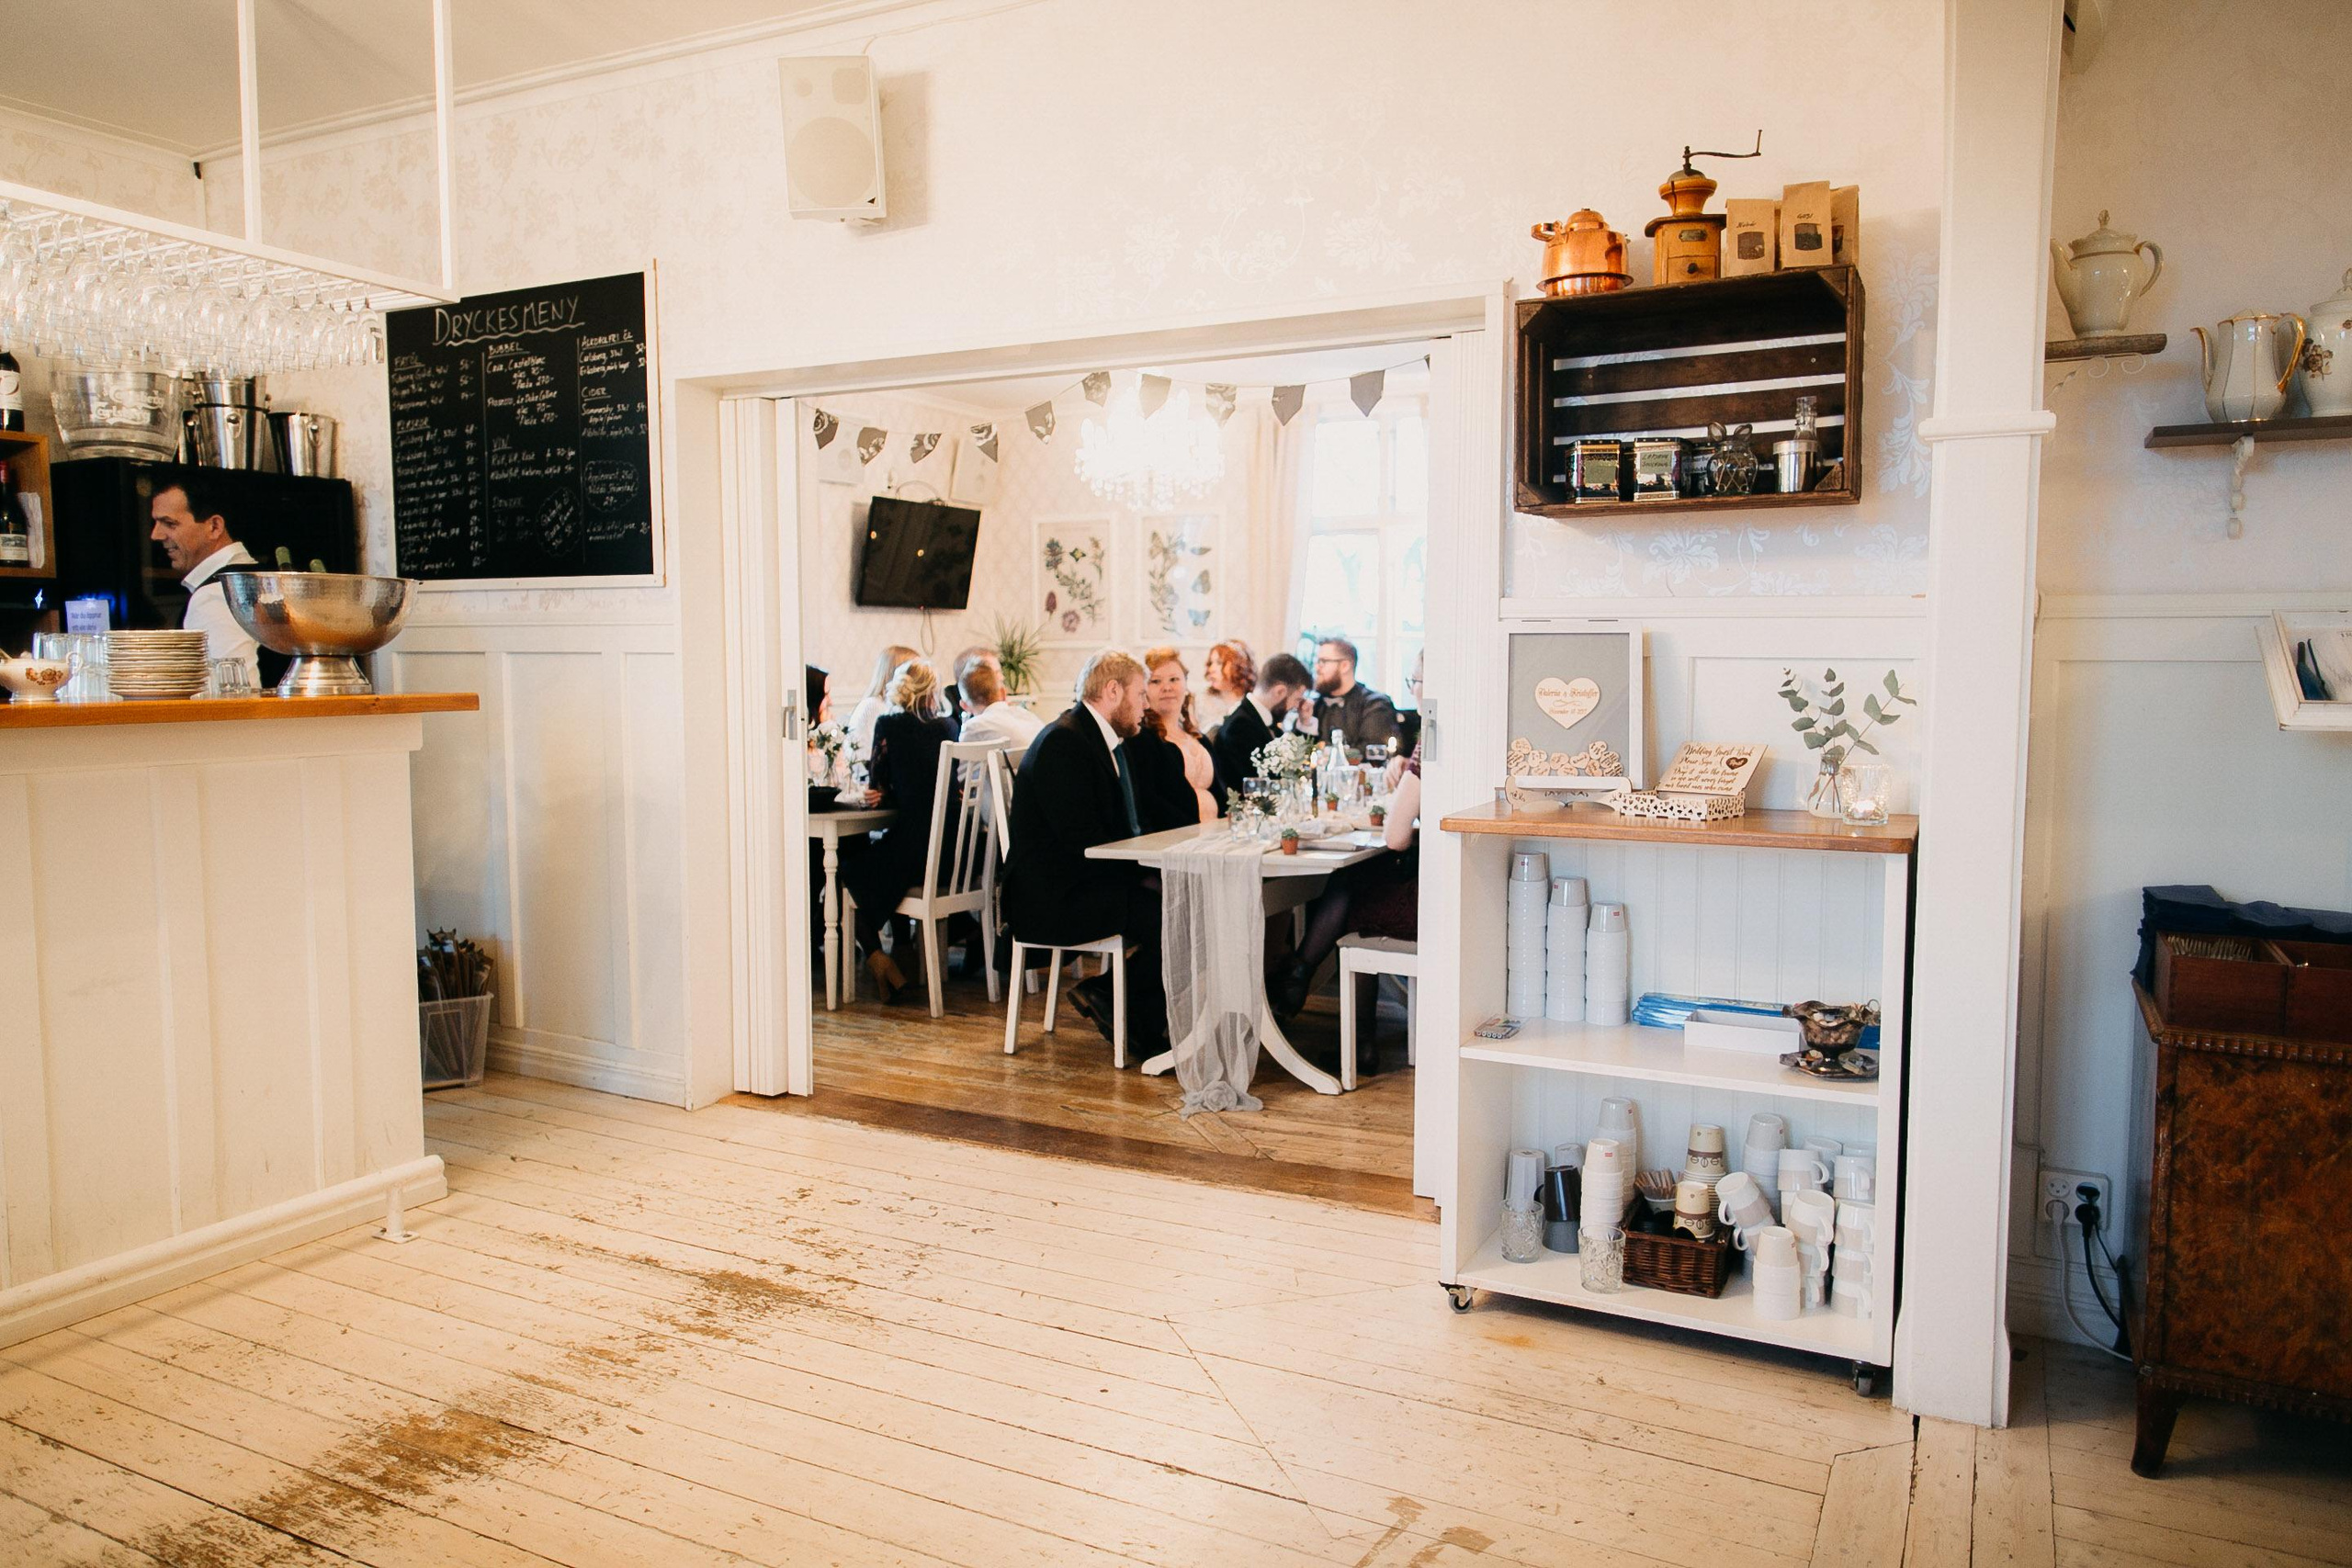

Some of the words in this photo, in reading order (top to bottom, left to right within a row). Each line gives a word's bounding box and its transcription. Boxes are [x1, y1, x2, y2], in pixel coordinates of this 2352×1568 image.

[433, 295, 579, 345] DRYCKESMENY
[488, 341, 524, 355] BUBBEL
[1684, 744, 1713, 757] Wedding
[1713, 745, 1735, 757] Guest
[1737, 746, 1755, 757] Book
[1679, 756, 1699, 765] Please
